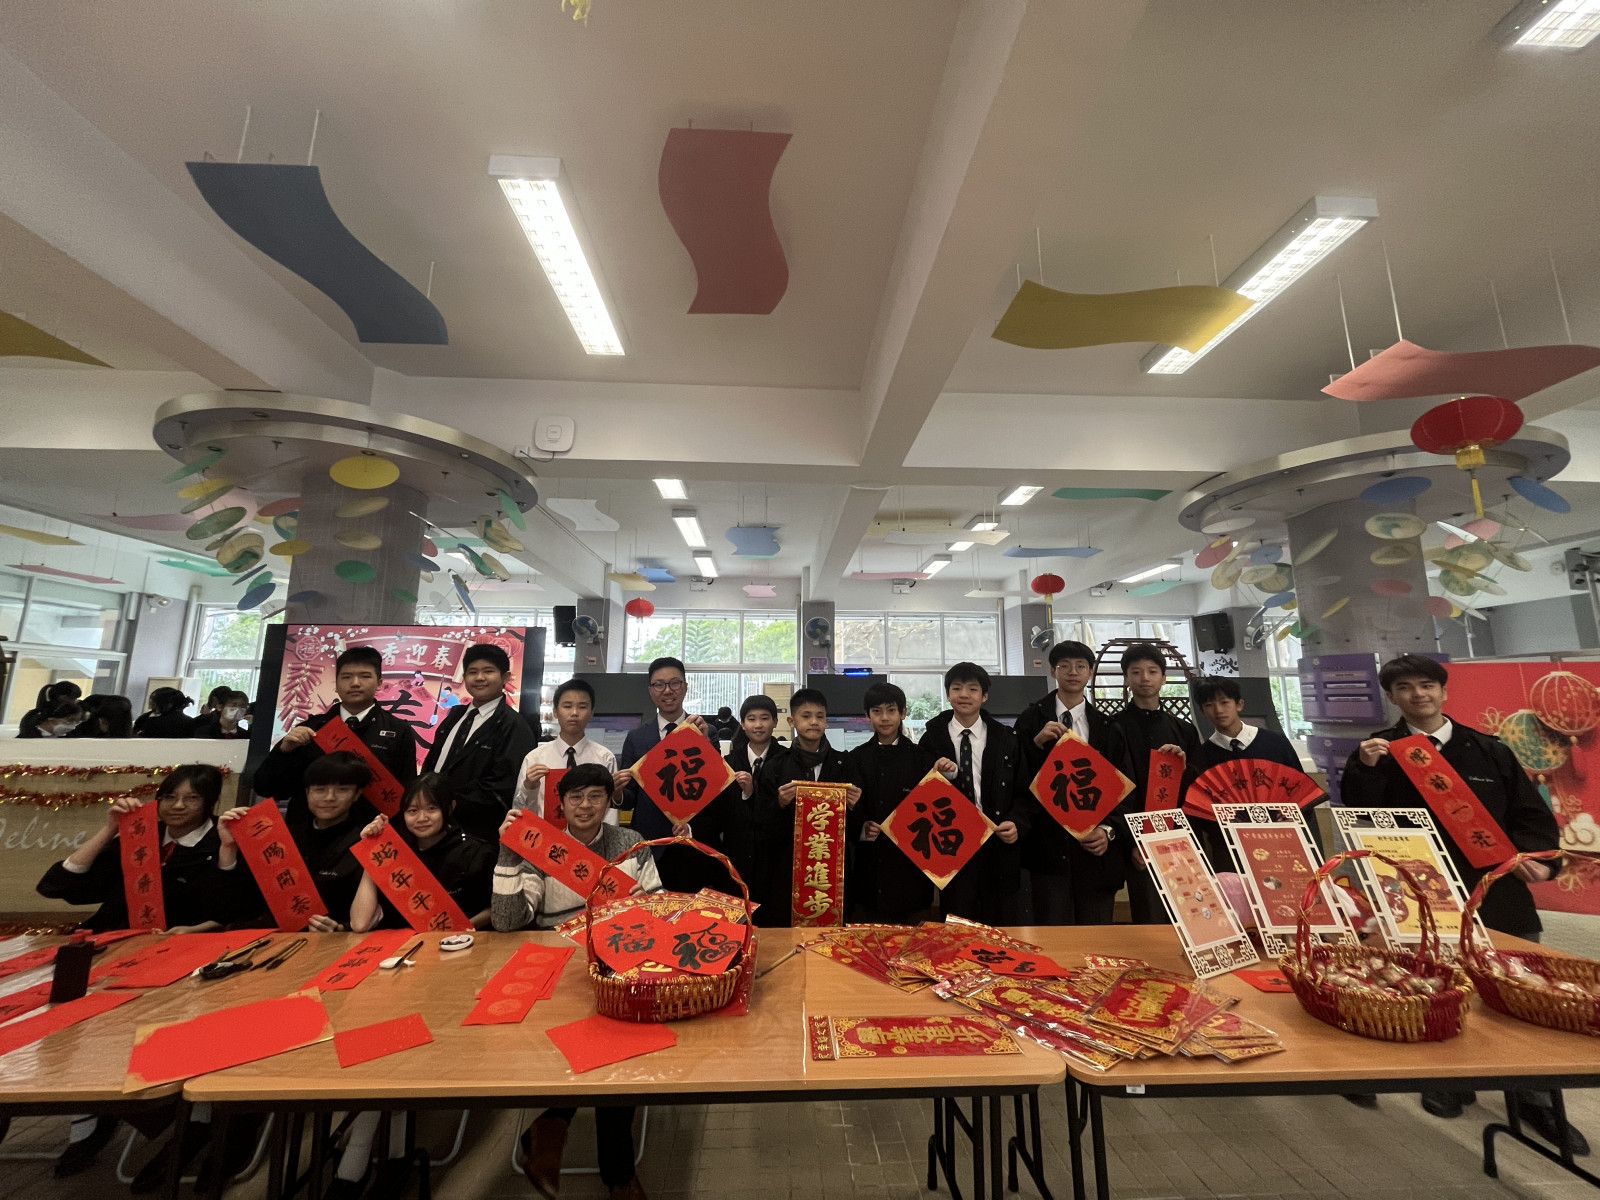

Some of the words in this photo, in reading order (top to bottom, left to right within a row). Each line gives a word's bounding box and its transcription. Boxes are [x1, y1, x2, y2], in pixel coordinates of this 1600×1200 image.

[364, 643, 453, 670] 香迎春
[659, 746, 709, 802] 福
[1050, 757, 1103, 812] 福
[907, 796, 965, 860] 福
[251, 820, 311, 915] 三陽開泰
[606, 922, 655, 954] 福
